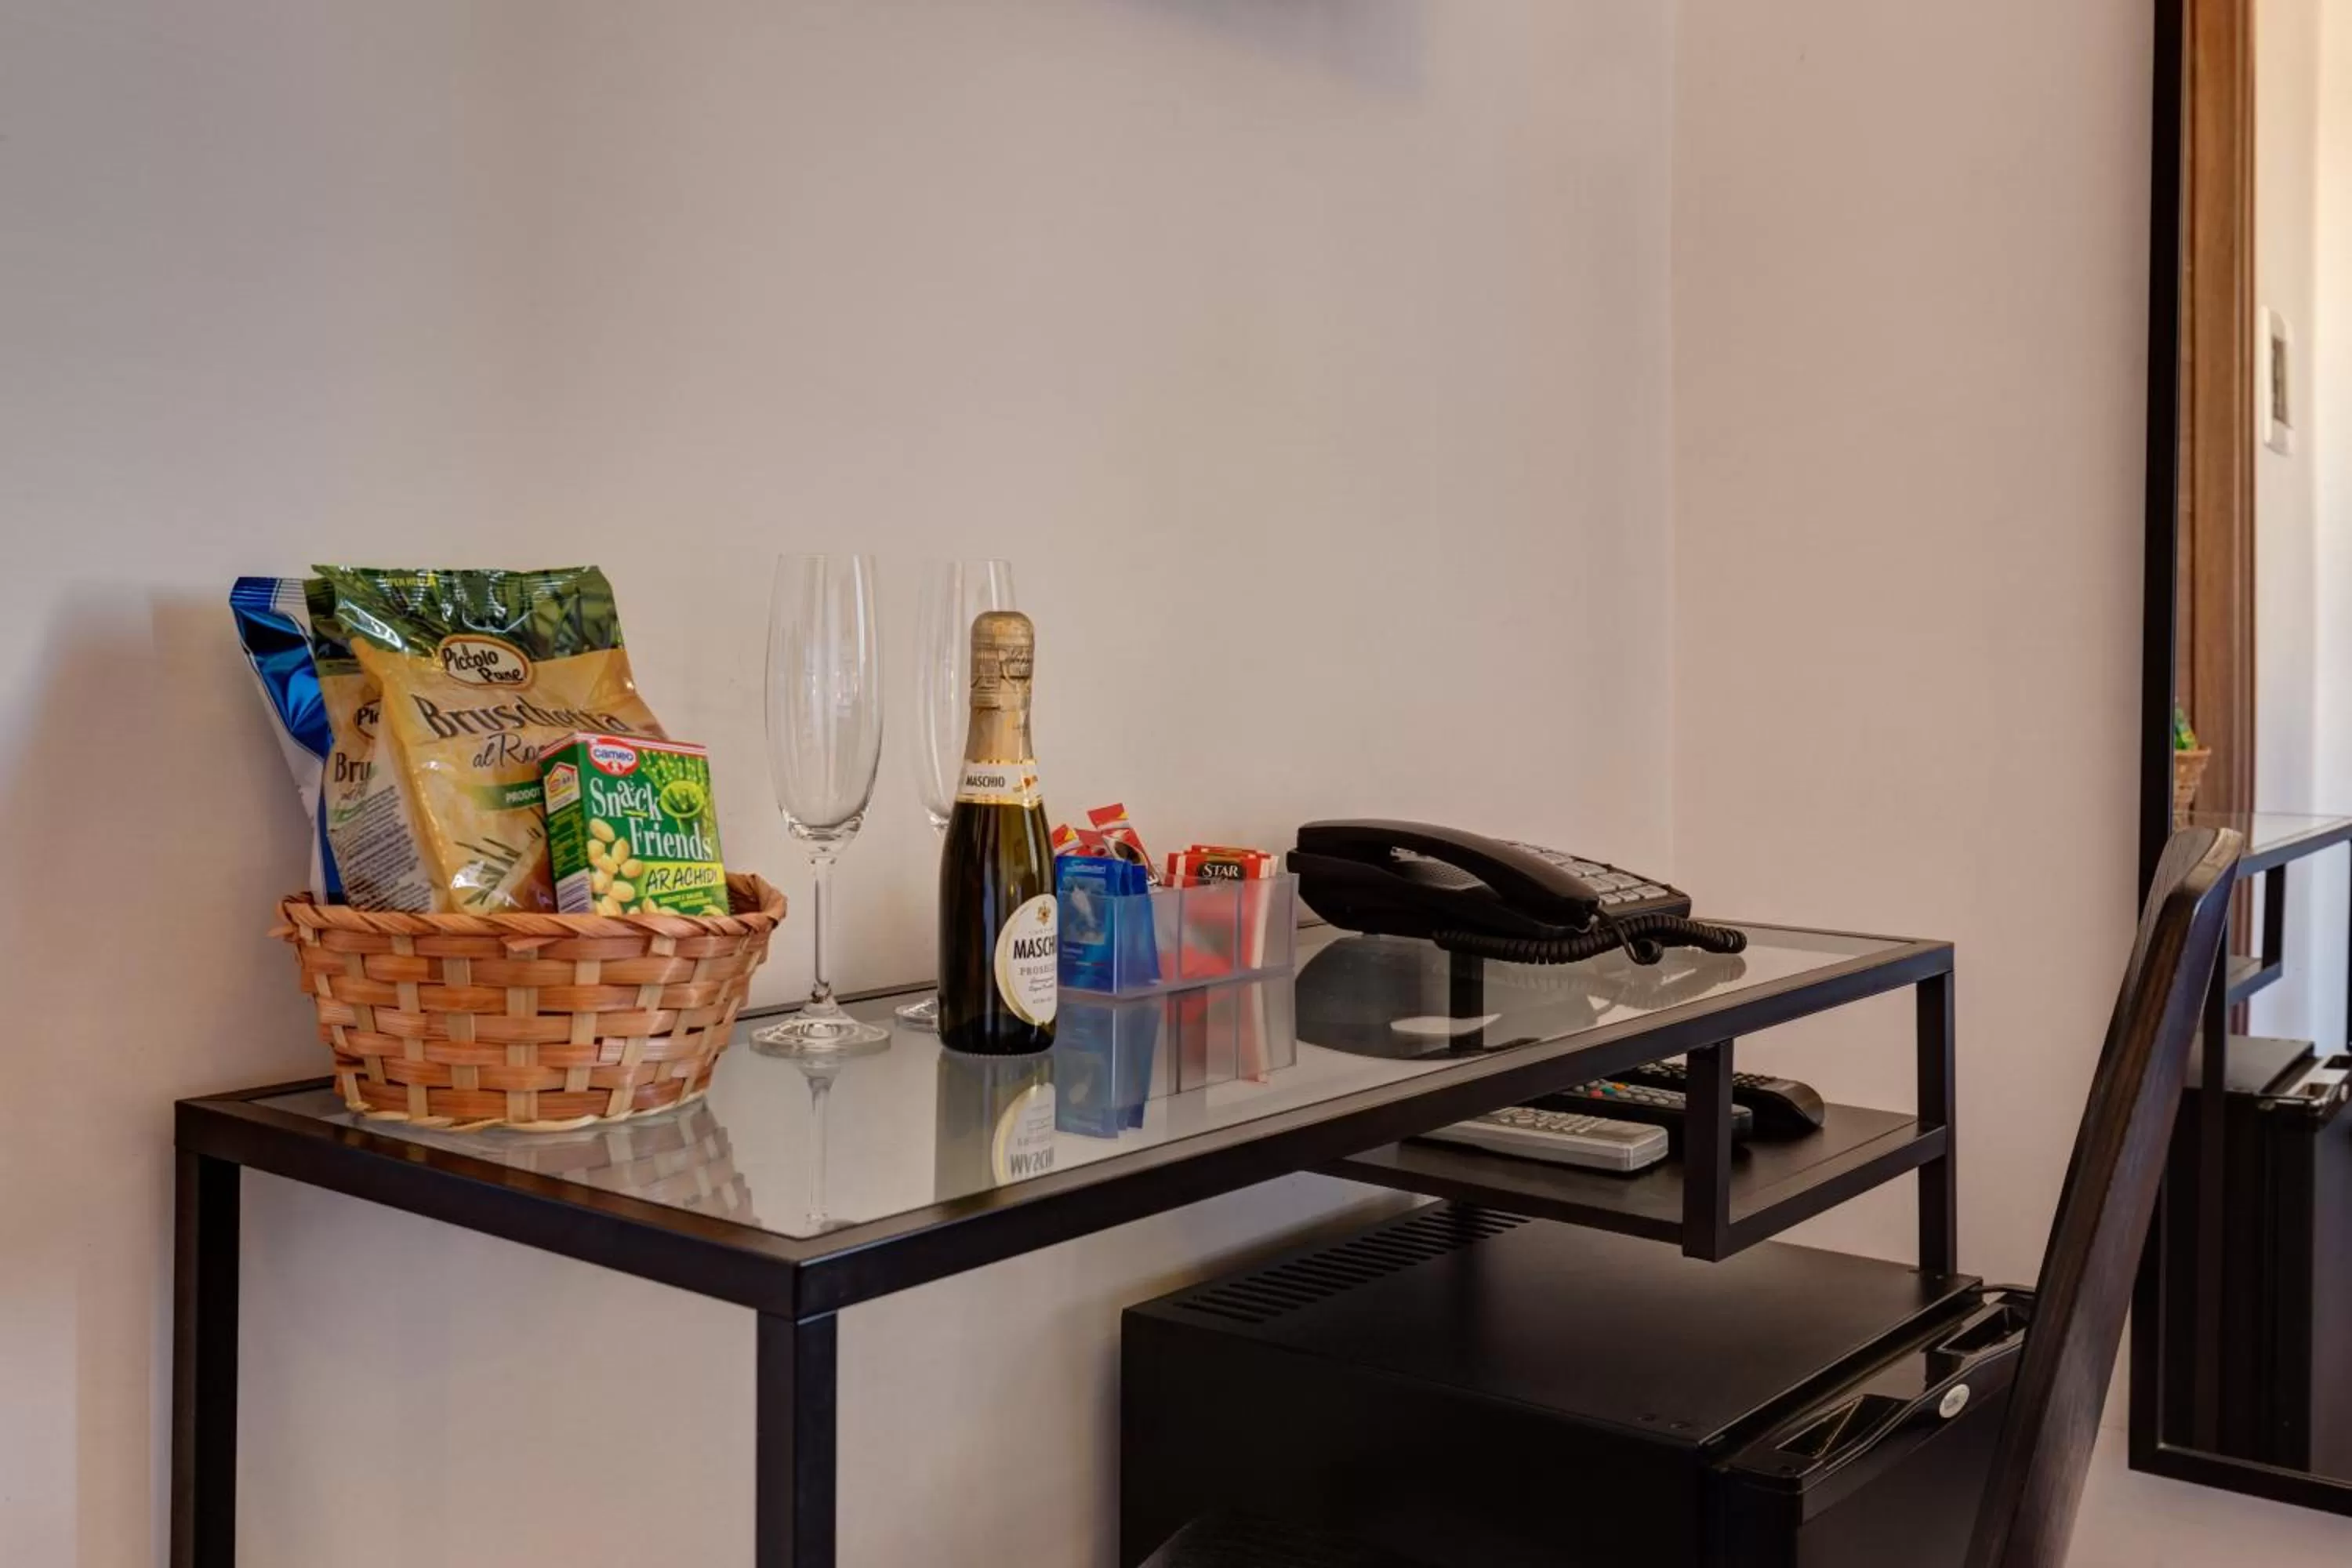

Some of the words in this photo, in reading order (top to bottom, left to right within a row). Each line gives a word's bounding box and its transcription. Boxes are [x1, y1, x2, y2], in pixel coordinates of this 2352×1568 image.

[441, 646, 499, 671] Piccolo
[477, 667, 524, 683] Pane
[473, 742, 494, 768] al
[593, 748, 634, 762] cameo
[966, 775, 1005, 787] MASCHIO
[590, 778, 663, 821] Snack
[629, 817, 713, 860] Friends
[1203, 864, 1239, 877] STAR
